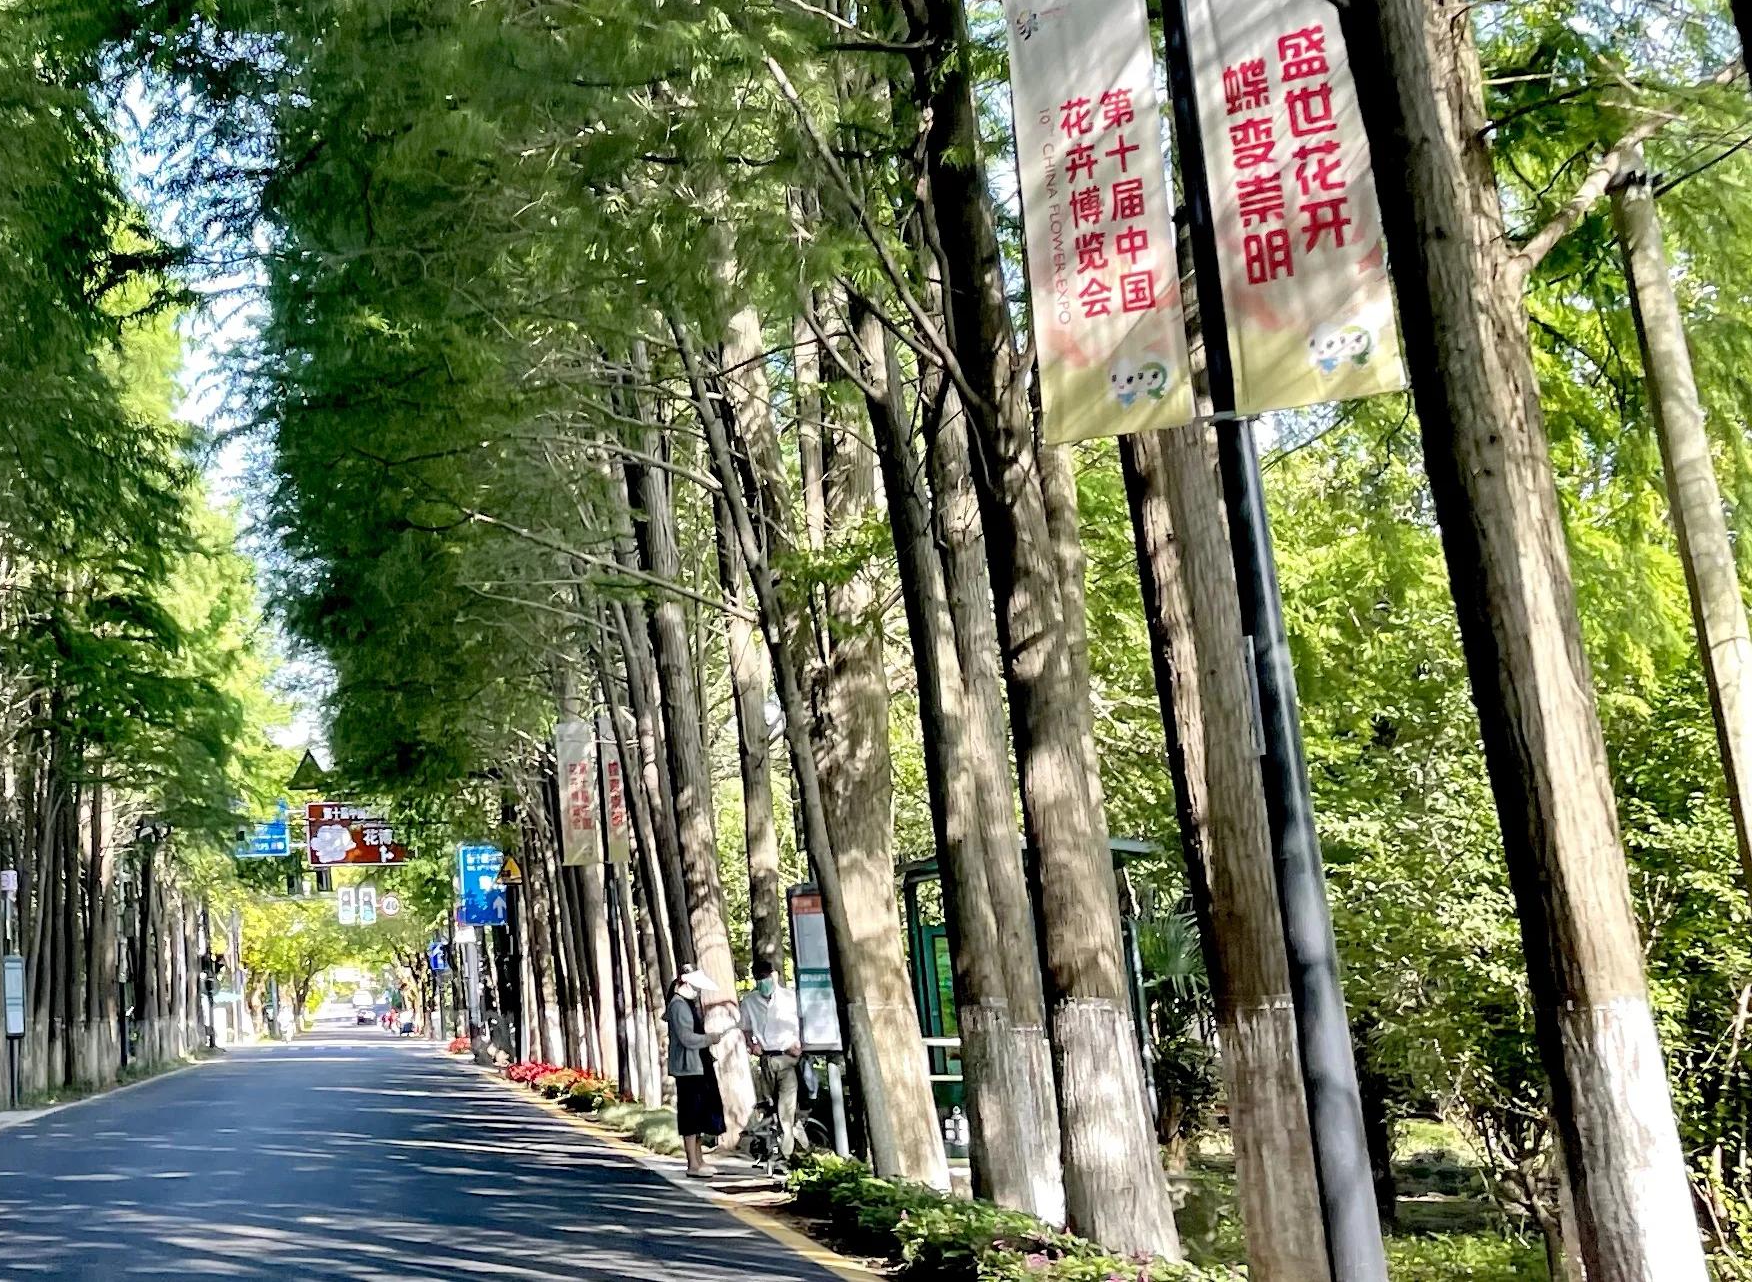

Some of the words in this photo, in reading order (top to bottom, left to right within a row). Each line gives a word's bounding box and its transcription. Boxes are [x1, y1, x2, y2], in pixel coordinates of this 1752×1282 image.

[1043, 142, 1058, 199] CHINA
[1048, 204, 1066, 275] FLOWER
[1059, 96, 1112, 318] 花卉博览会
[1099, 87, 1156, 313] 第十届中国
[1223, 56, 1294, 285] 蝶变崇明
[1277, 24, 1351, 254] 盛世花开
[1055, 276, 1072, 326] EXPO
